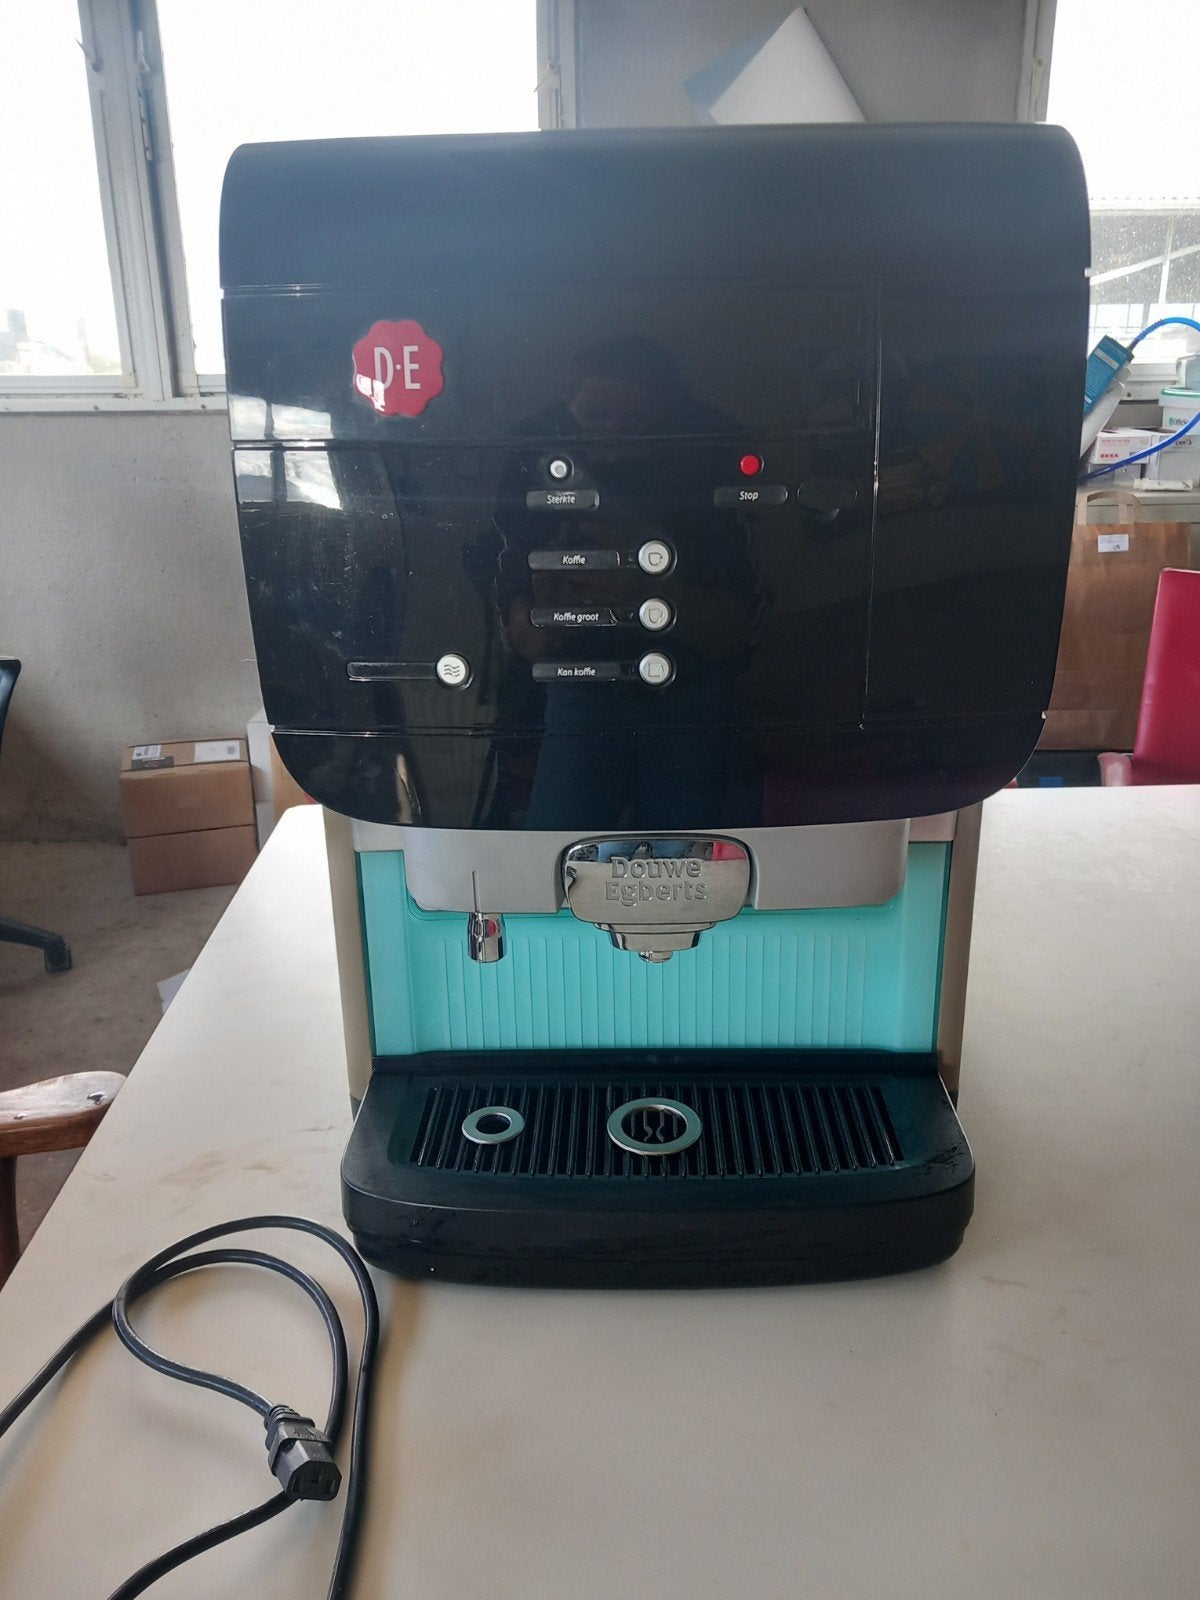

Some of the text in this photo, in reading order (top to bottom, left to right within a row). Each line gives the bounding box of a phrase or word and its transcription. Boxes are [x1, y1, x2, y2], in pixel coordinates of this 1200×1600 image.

[547, 494, 576, 505] Sterkte
[739, 490, 759, 502] Stop
[562, 555, 586, 565] Koffie
[553, 612, 599, 623] Koffie groot
[557, 666, 596, 676] Kan koffie
[610, 856, 702, 879] Douwe
[605, 881, 707, 907] Egberts
